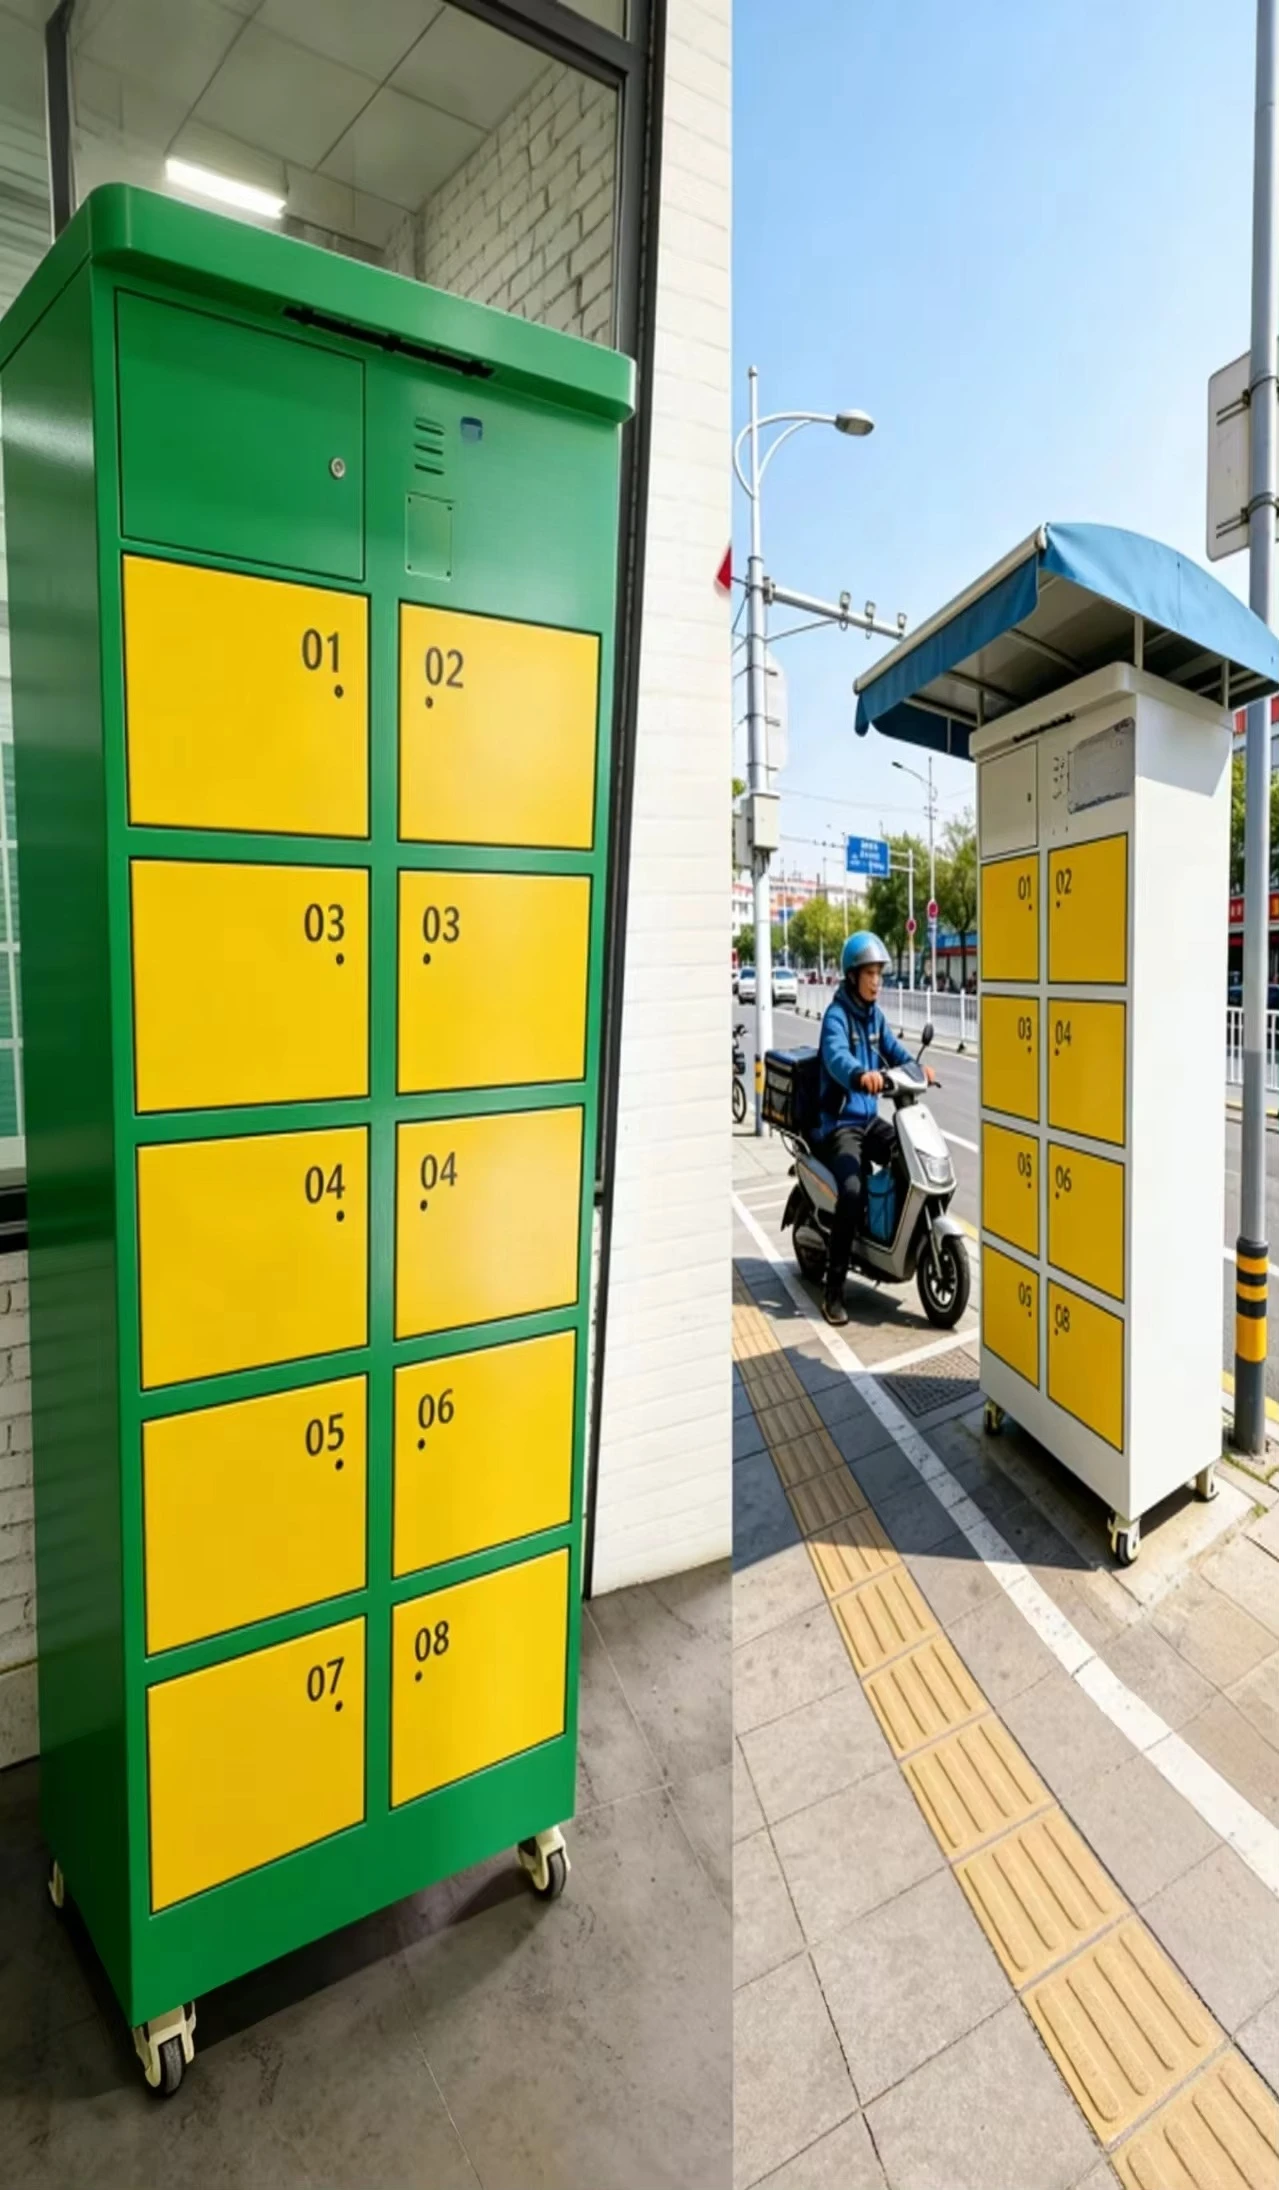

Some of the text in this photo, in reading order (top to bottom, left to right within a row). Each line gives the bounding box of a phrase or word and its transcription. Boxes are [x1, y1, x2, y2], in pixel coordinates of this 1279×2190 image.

[302, 628, 340, 672] 01
[425, 647, 464, 688] 02
[1017, 874, 1032, 900] 01
[1055, 867, 1073, 894] 02
[304, 904, 345, 943] 03
[423, 906, 460, 943] 03
[1017, 1016, 1033, 1041] 03
[1055, 1019, 1072, 1046] 04
[305, 1164, 346, 1204] 04
[421, 1151, 458, 1190] 04
[1055, 1164, 1072, 1193] 06
[418, 1389, 455, 1429] 06
[305, 1413, 345, 1457] 05
[415, 1621, 450, 1663] 08
[306, 1657, 345, 1702] 07
